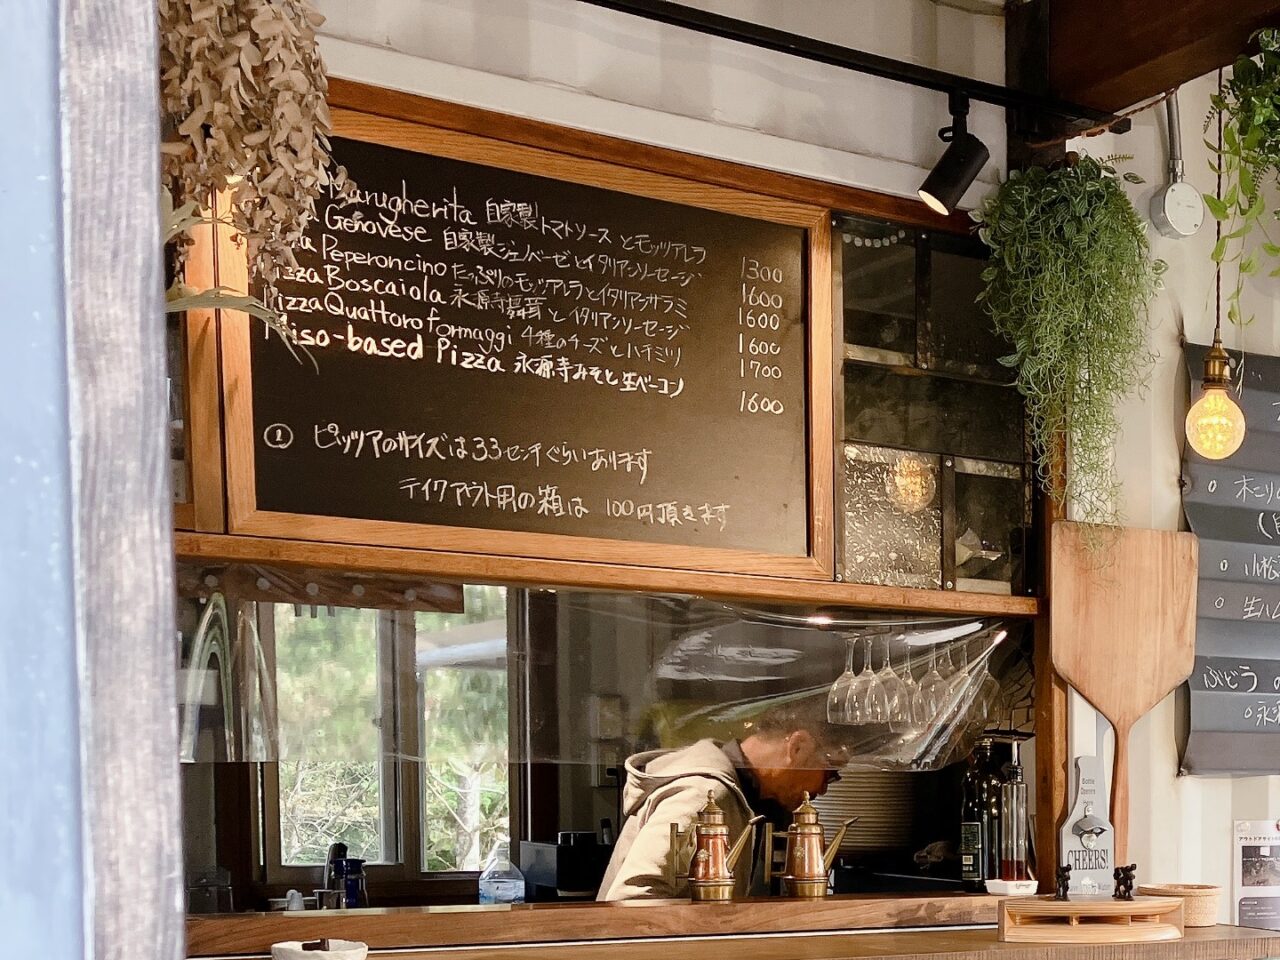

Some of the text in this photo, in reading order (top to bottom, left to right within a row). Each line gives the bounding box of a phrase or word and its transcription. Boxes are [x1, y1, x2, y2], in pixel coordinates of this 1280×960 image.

[322, 234, 447, 277] Peperoncino
[739, 307, 780, 331] 1600
[741, 256, 783, 284] 1300
[742, 283, 782, 309] 1600
[323, 264, 447, 304] Boscaiola
[739, 333, 781, 355] 1600
[427, 307, 513, 354] formaggi
[741, 359, 782, 379] 1700
[437, 338, 505, 373] Pizza
[740, 391, 784, 415] 1600
[1067, 848, 1109, 871] CHEERS!
